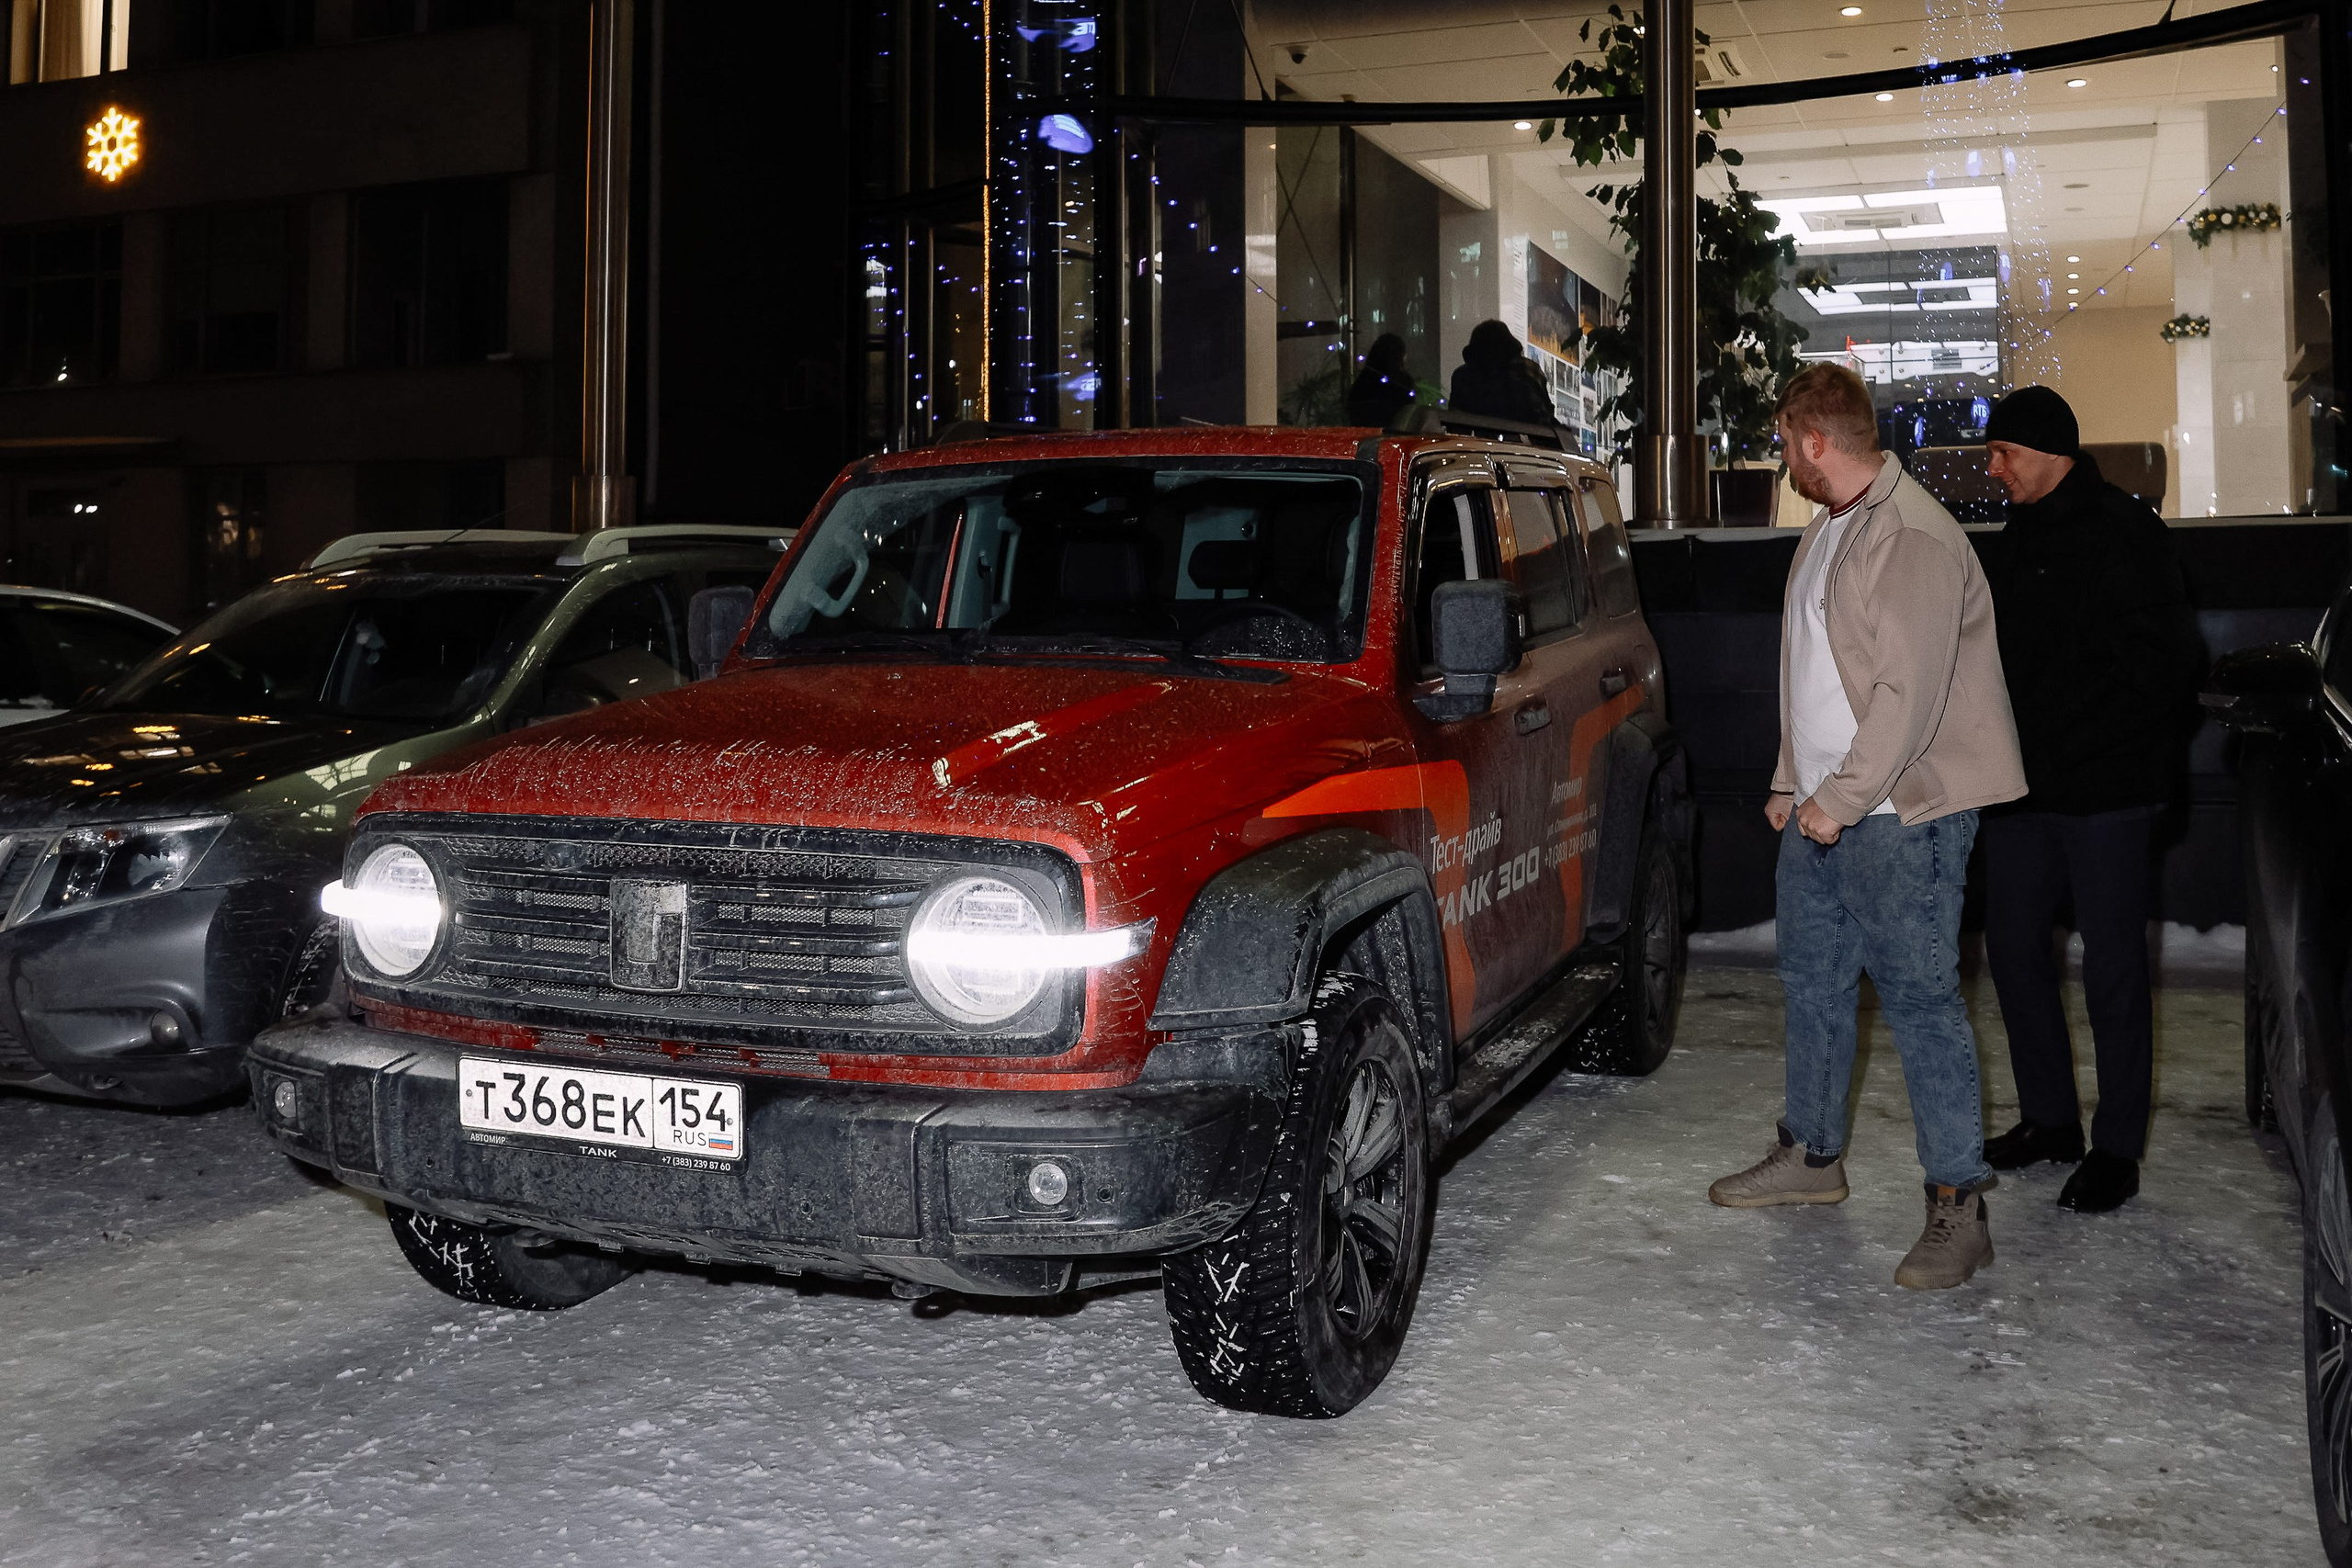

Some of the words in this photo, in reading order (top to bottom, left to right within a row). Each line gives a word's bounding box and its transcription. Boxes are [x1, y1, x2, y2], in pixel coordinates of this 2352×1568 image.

[1430, 811, 1502, 874] Тест-драйв
[1553, 840, 1567, 870] (383)
[1588, 828, 1597, 849] 60
[1497, 846, 1541, 901] 300
[475, 1072, 646, 1138] Т368ЕК
[659, 1087, 726, 1132] 154
[469, 1133, 506, 1145] АВТОМИР
[579, 1145, 617, 1158] TANK
[673, 1129, 707, 1146] RUS
[662, 1156, 672, 1165] +7
[673, 1157, 692, 1168] (383)
[694, 1159, 708, 1169] 239
[708, 1161, 718, 1169] 87
[719, 1162, 731, 1171] 60
